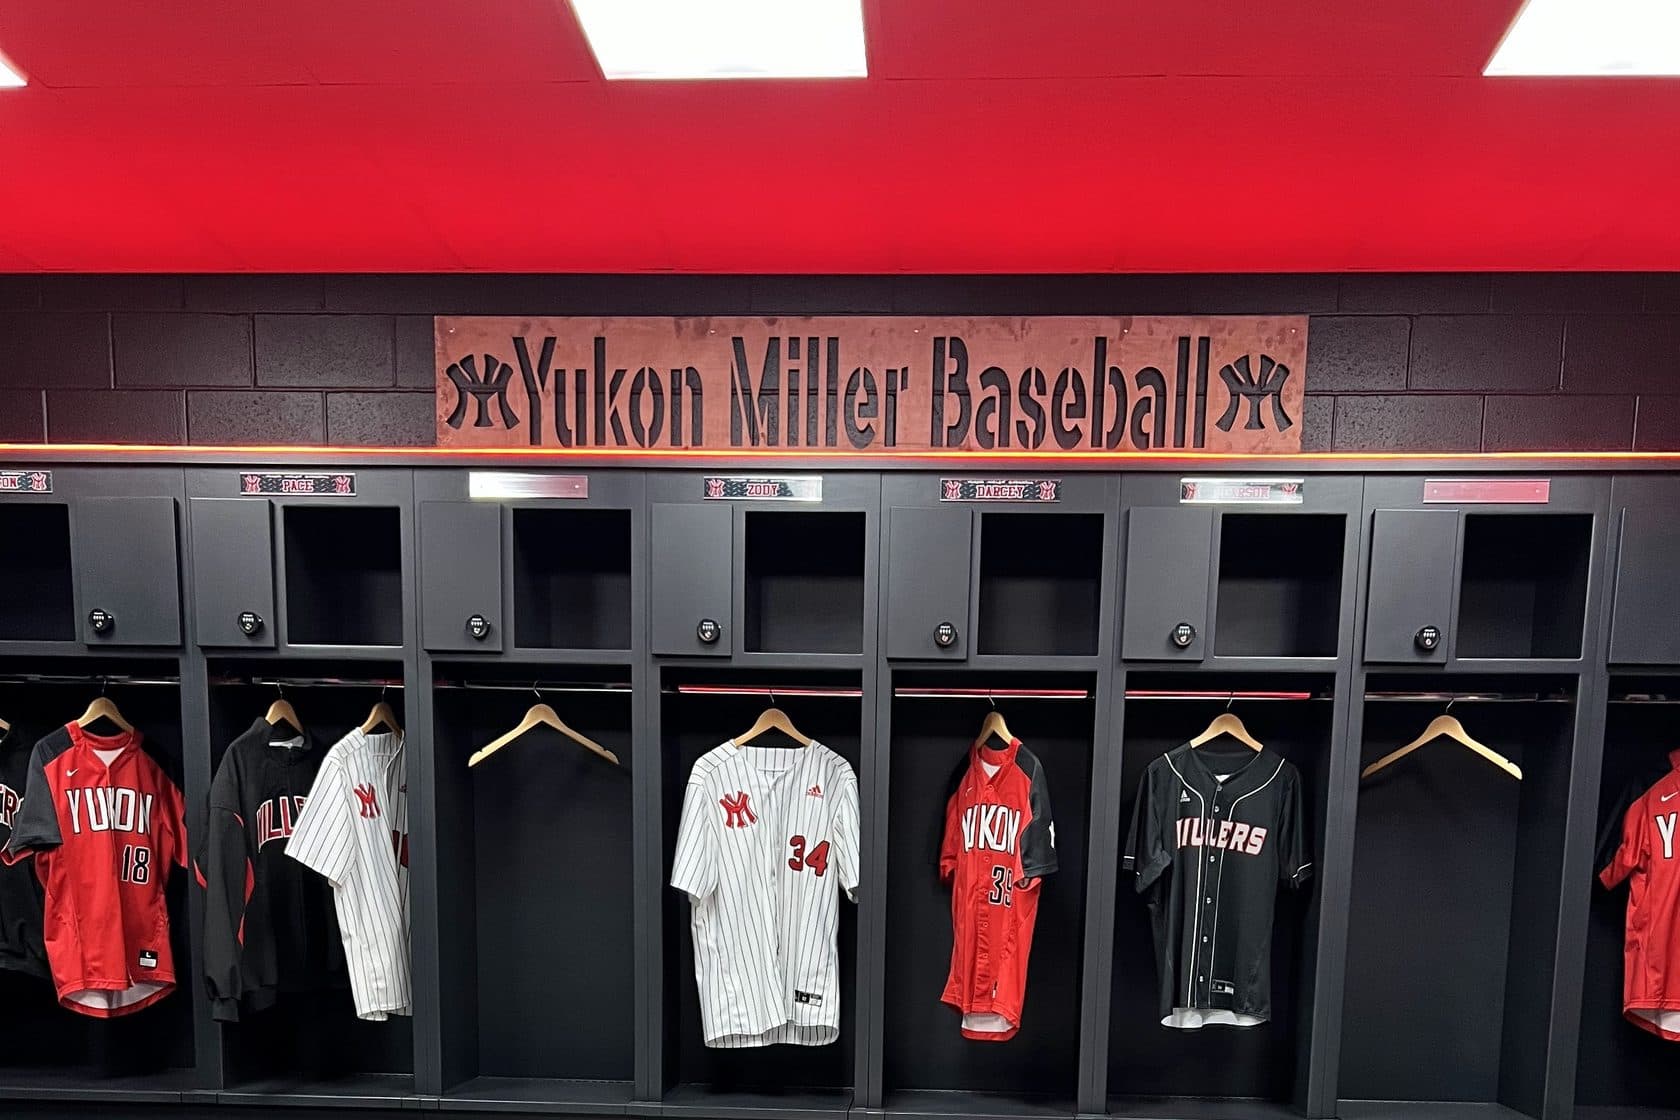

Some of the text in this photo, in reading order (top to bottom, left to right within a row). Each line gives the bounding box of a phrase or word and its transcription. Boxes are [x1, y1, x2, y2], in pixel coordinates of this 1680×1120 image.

[512, 336, 704, 448] Yukon
[730, 336, 908, 448] Miller
[930, 336, 1211, 450] Baseball
[282, 479, 314, 492] PACE
[747, 483, 779, 497] ZODY
[976, 485, 1024, 498] DARCEY
[121, 844, 150, 885] 18
[788, 835, 830, 877] 34
